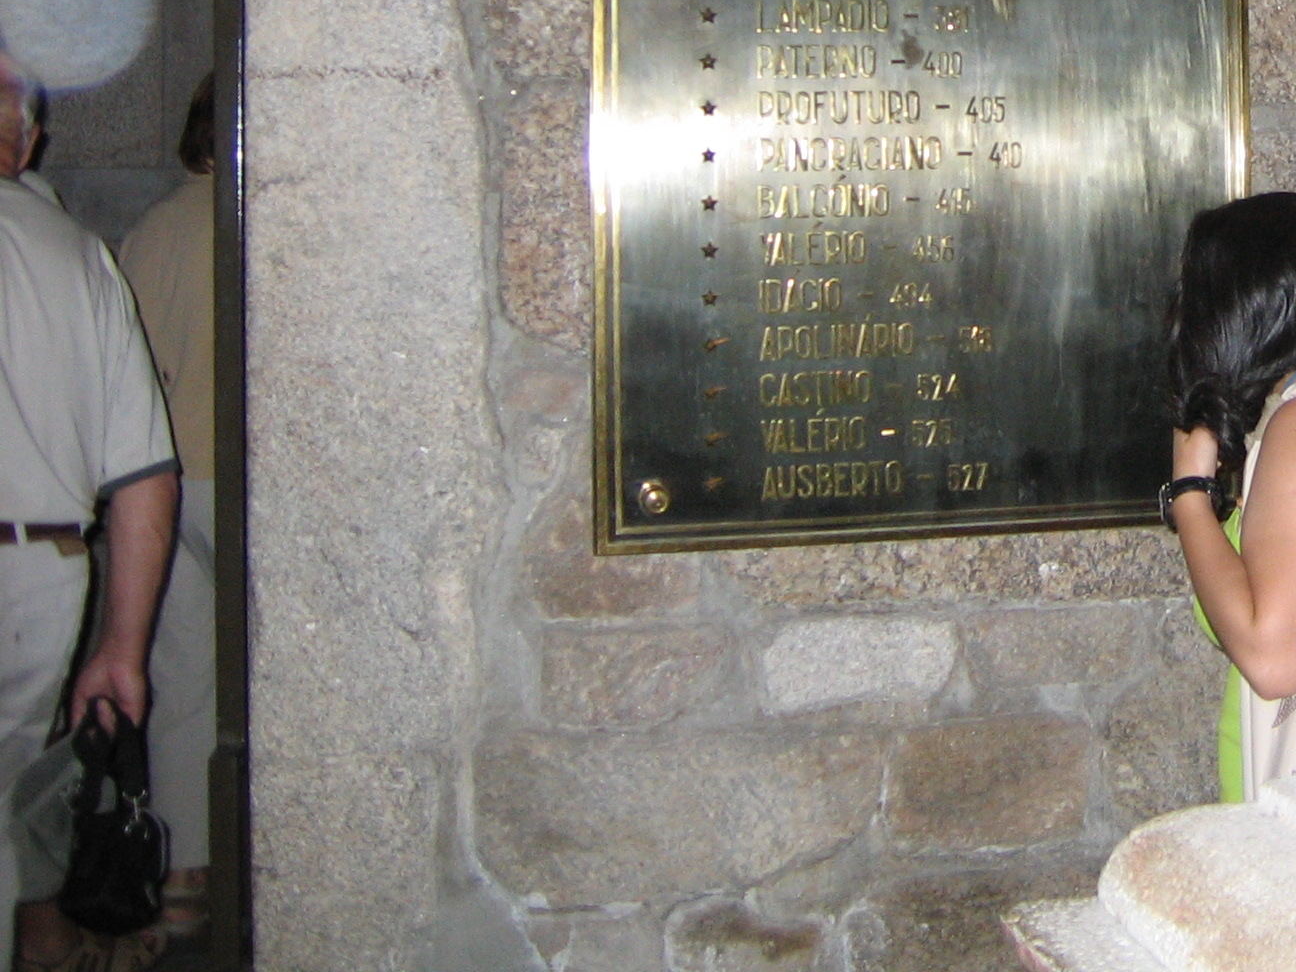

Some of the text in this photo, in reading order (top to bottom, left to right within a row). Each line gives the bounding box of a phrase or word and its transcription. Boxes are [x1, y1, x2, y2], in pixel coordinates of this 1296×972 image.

[756, 44, 963, 79] PATERNO 400
[756, 89, 1006, 125] PROFUTURO 405
[756, 135, 1023, 172] PANCRACIANO 410
[759, 369, 871, 408] CASTINO
[761, 460, 989, 502] AUSBERTO 527
